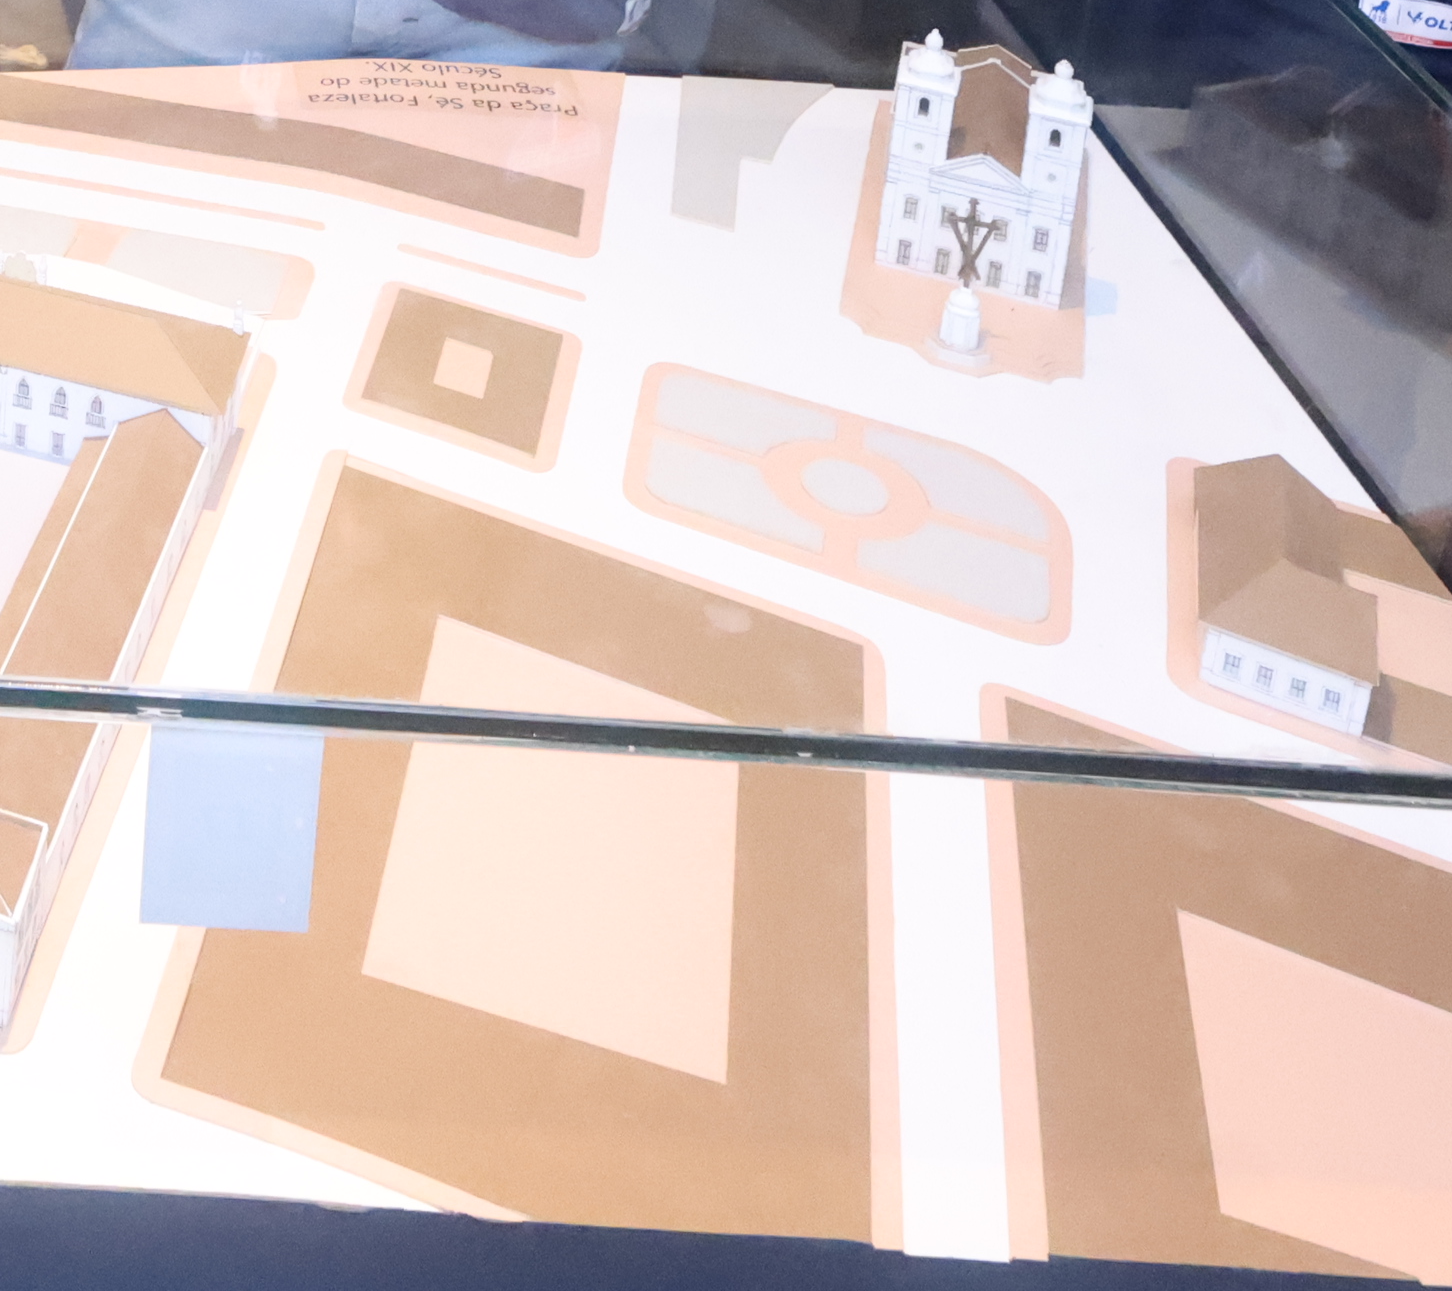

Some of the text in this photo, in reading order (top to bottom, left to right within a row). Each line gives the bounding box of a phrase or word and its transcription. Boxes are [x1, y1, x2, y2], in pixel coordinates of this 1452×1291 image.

[421, 63, 503, 79] Século
[359, 77, 557, 97] segunda metade
[308, 92, 579, 117] Praça Sé, Fortaleza
